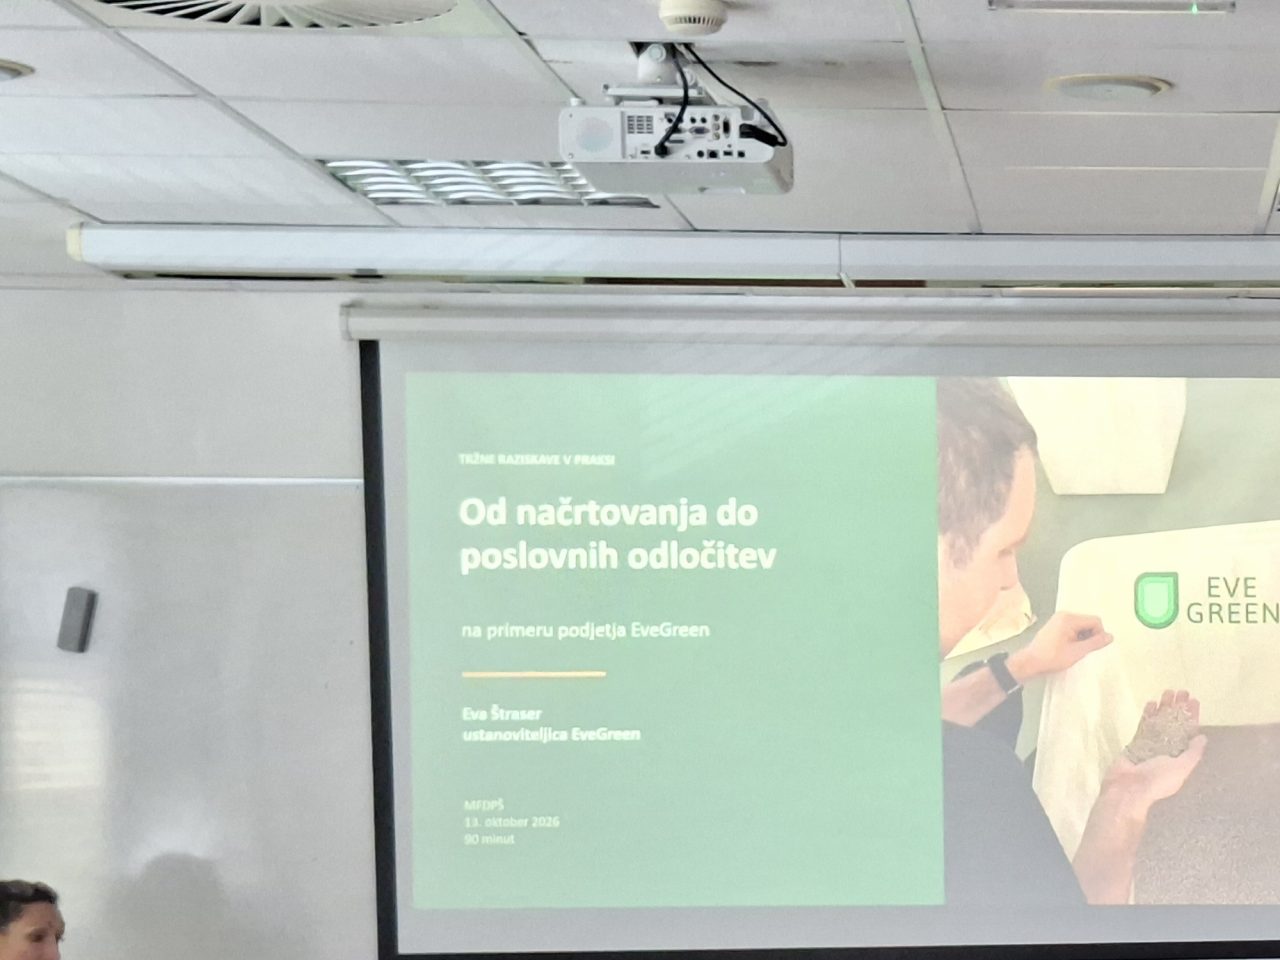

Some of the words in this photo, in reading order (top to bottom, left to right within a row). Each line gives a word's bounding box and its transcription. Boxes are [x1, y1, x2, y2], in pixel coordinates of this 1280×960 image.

[563, 453, 571, 465] V
[459, 496, 507, 526] Od
[517, 496, 707, 532] načrtovanja
[716, 496, 758, 526] do
[461, 540, 618, 575] poslovnih
[627, 539, 777, 569] odločitev
[1207, 576, 1256, 598] EVE
[1187, 602, 1280, 624] GREEN
[462, 625, 482, 638] na
[487, 622, 554, 640] primeru
[558, 622, 627, 640] podjetja
[631, 622, 711, 638] EveGreen
[462, 707, 488, 721] Eva
[491, 704, 543, 721] Štraser
[463, 727, 568, 743] ustanoviteljica
[571, 727, 641, 741] EveGreen
[484, 816, 529, 828] oktober
[481, 834, 515, 845] minut
